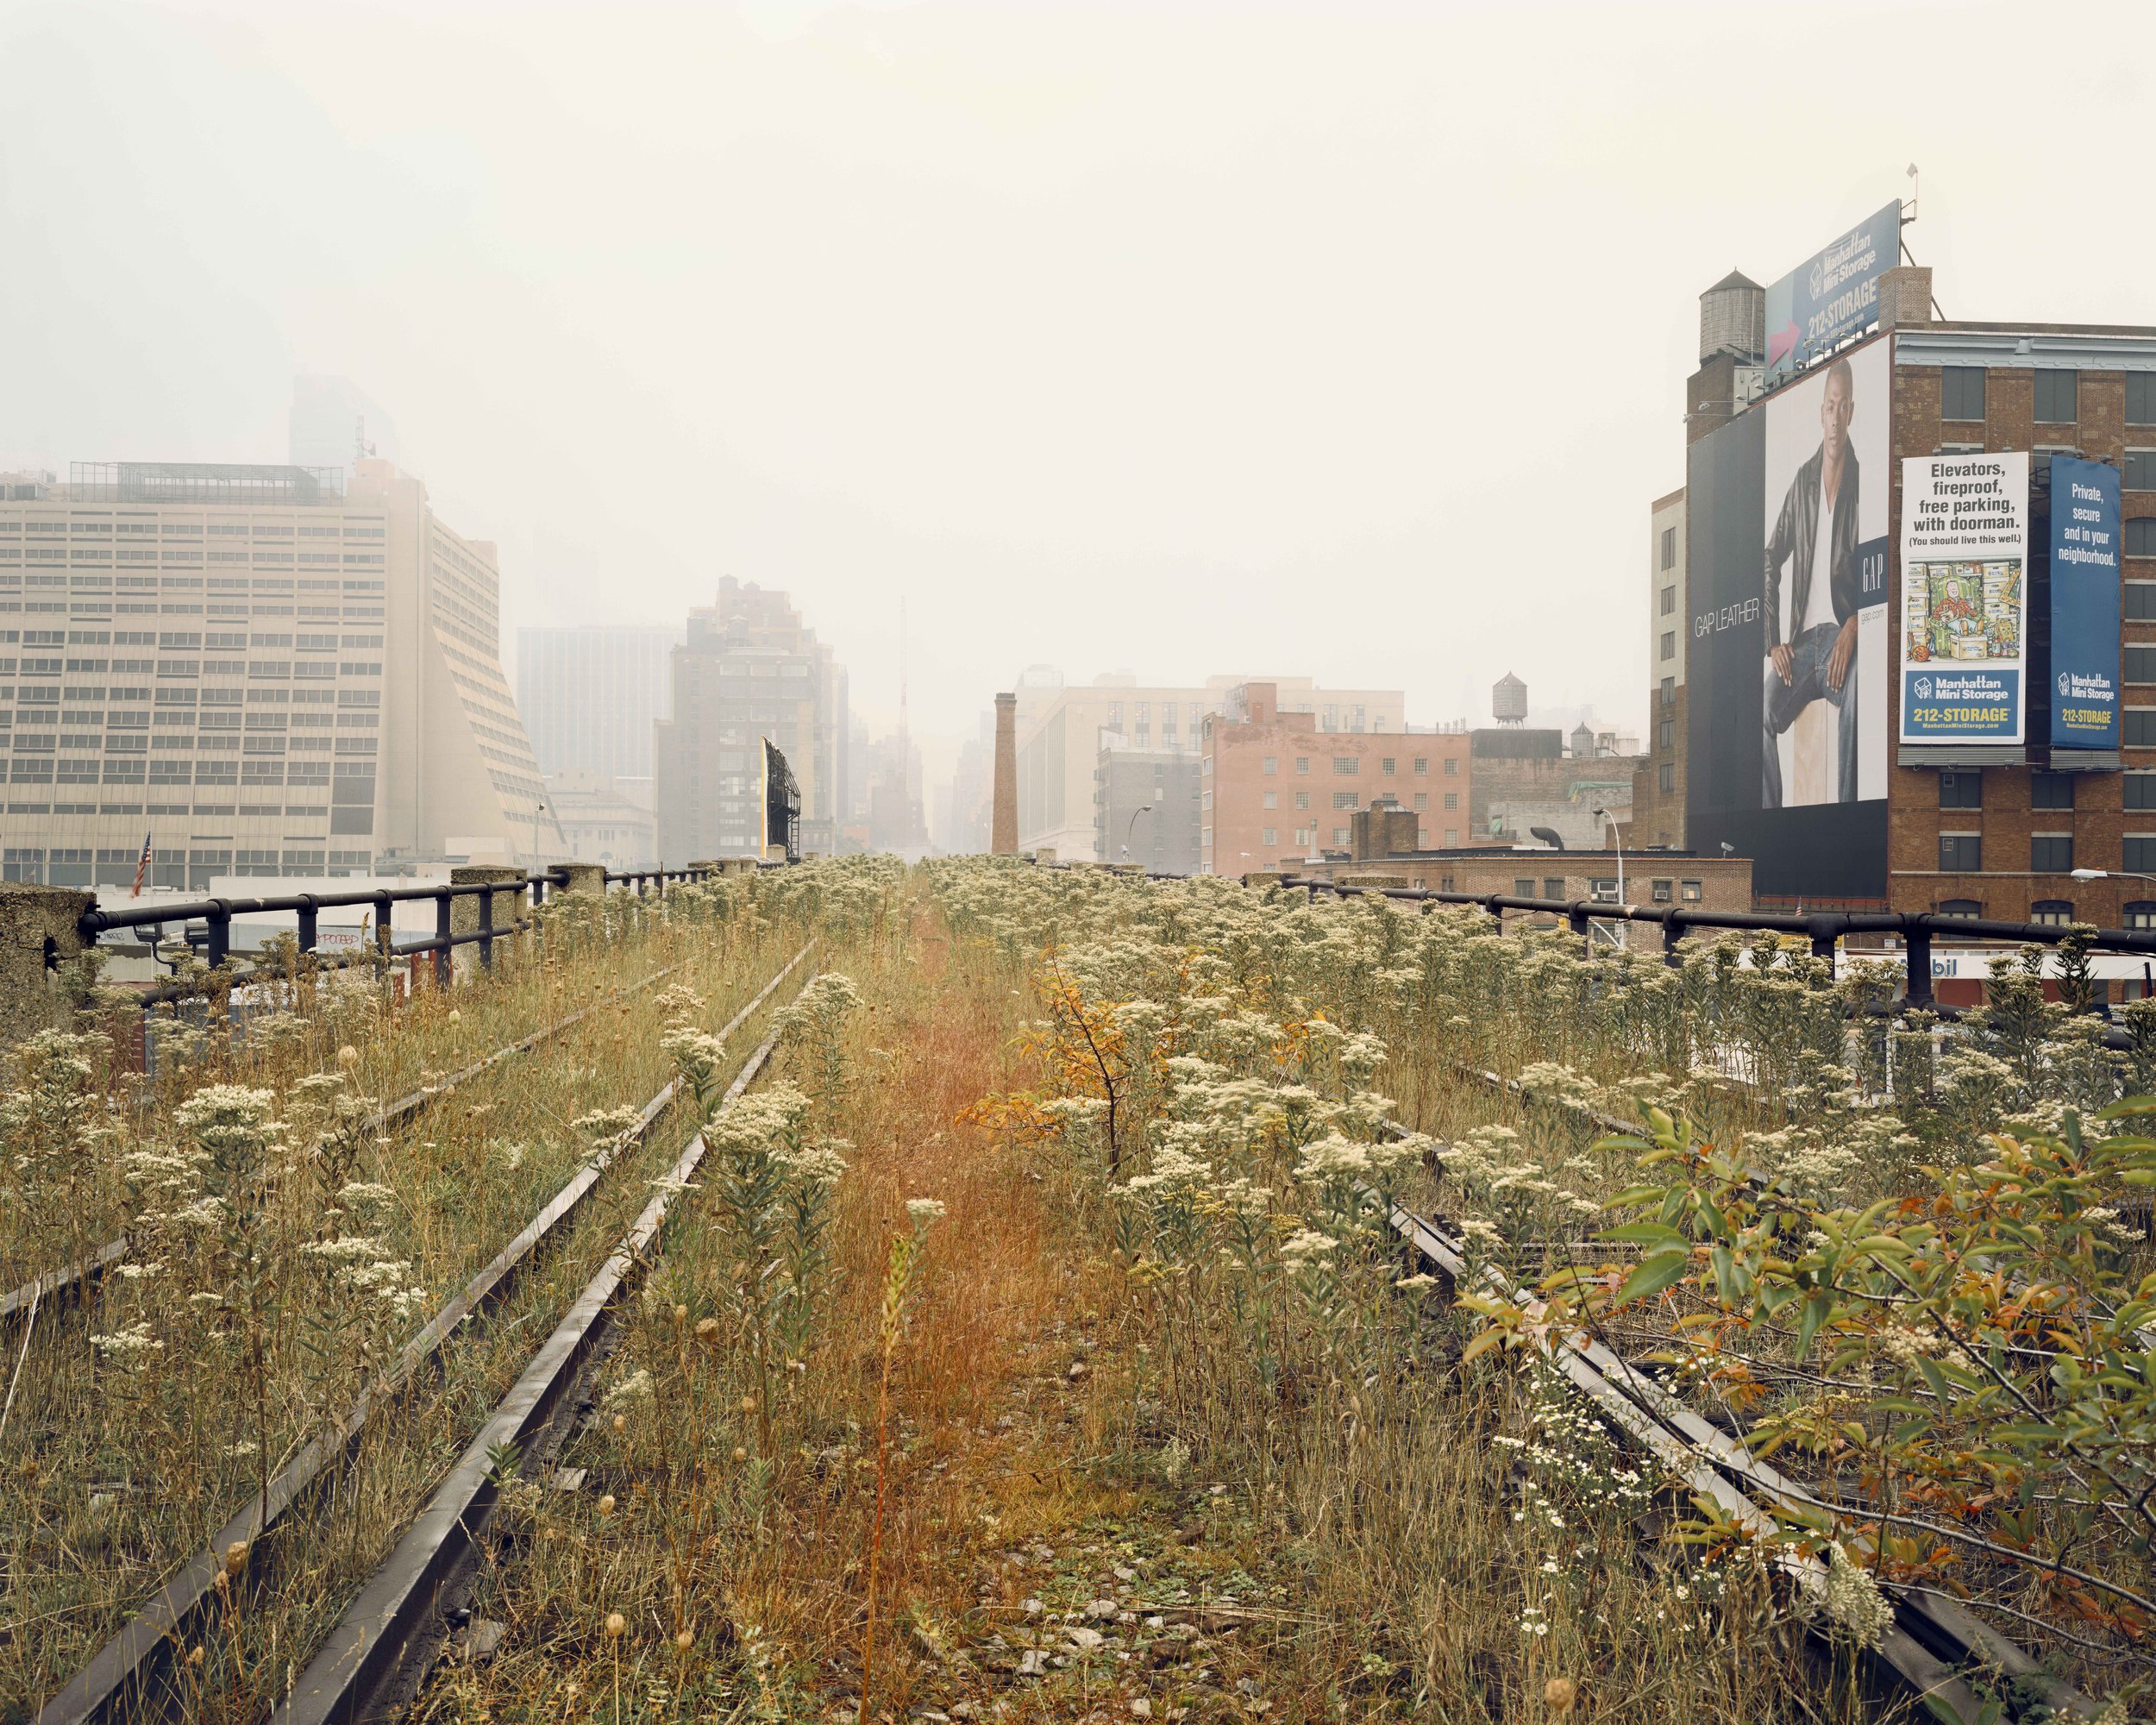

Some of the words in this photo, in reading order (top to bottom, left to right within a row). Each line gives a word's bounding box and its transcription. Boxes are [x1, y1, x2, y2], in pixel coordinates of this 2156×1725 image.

[1824, 231, 1871, 276] Manhattan
[1823, 269, 1839, 294] Mini
[1839, 249, 1876, 282] Storage
[1808, 276, 1877, 340] 212-STORAGE
[1931, 462, 2005, 478] Elevators,
[1933, 479, 2002, 498] fireproof,
[2071, 483, 2104, 505] Private,
[1919, 499, 1949, 514] free
[1953, 498, 2015, 516] parking,
[2072, 507, 2101, 523] secure
[1914, 517, 1946, 532] with
[1950, 516, 2020, 530] doorman.
[1908, 536, 1927, 548] (You
[1929, 536, 1959, 545] should
[1961, 536, 1977, 544] live
[1979, 535, 1996, 544] this
[1998, 533, 2021, 544] well.)
[2064, 526, 2080, 541] and
[2082, 527, 2090, 542] in
[2091, 530, 2109, 546] your
[2059, 546, 2116, 567] neighborhood.
[1863, 553, 1883, 593] GAP
[1695, 612, 1714, 638] GAP
[1715, 597, 1760, 632] LEATHER
[1861, 609, 1884, 624] gap.com
[1936, 675, 2001, 689] Manhattan
[2071, 673, 2110, 688] Manhattan
[1935, 689, 1960, 699] Mini
[1961, 689, 2009, 701] Storage
[2071, 687, 2087, 698] Mini
[2087, 687, 2115, 701] Storage
[1914, 707, 2009, 722] 212-STORAGE
[2062, 708, 2111, 724] 212-STORAGE
